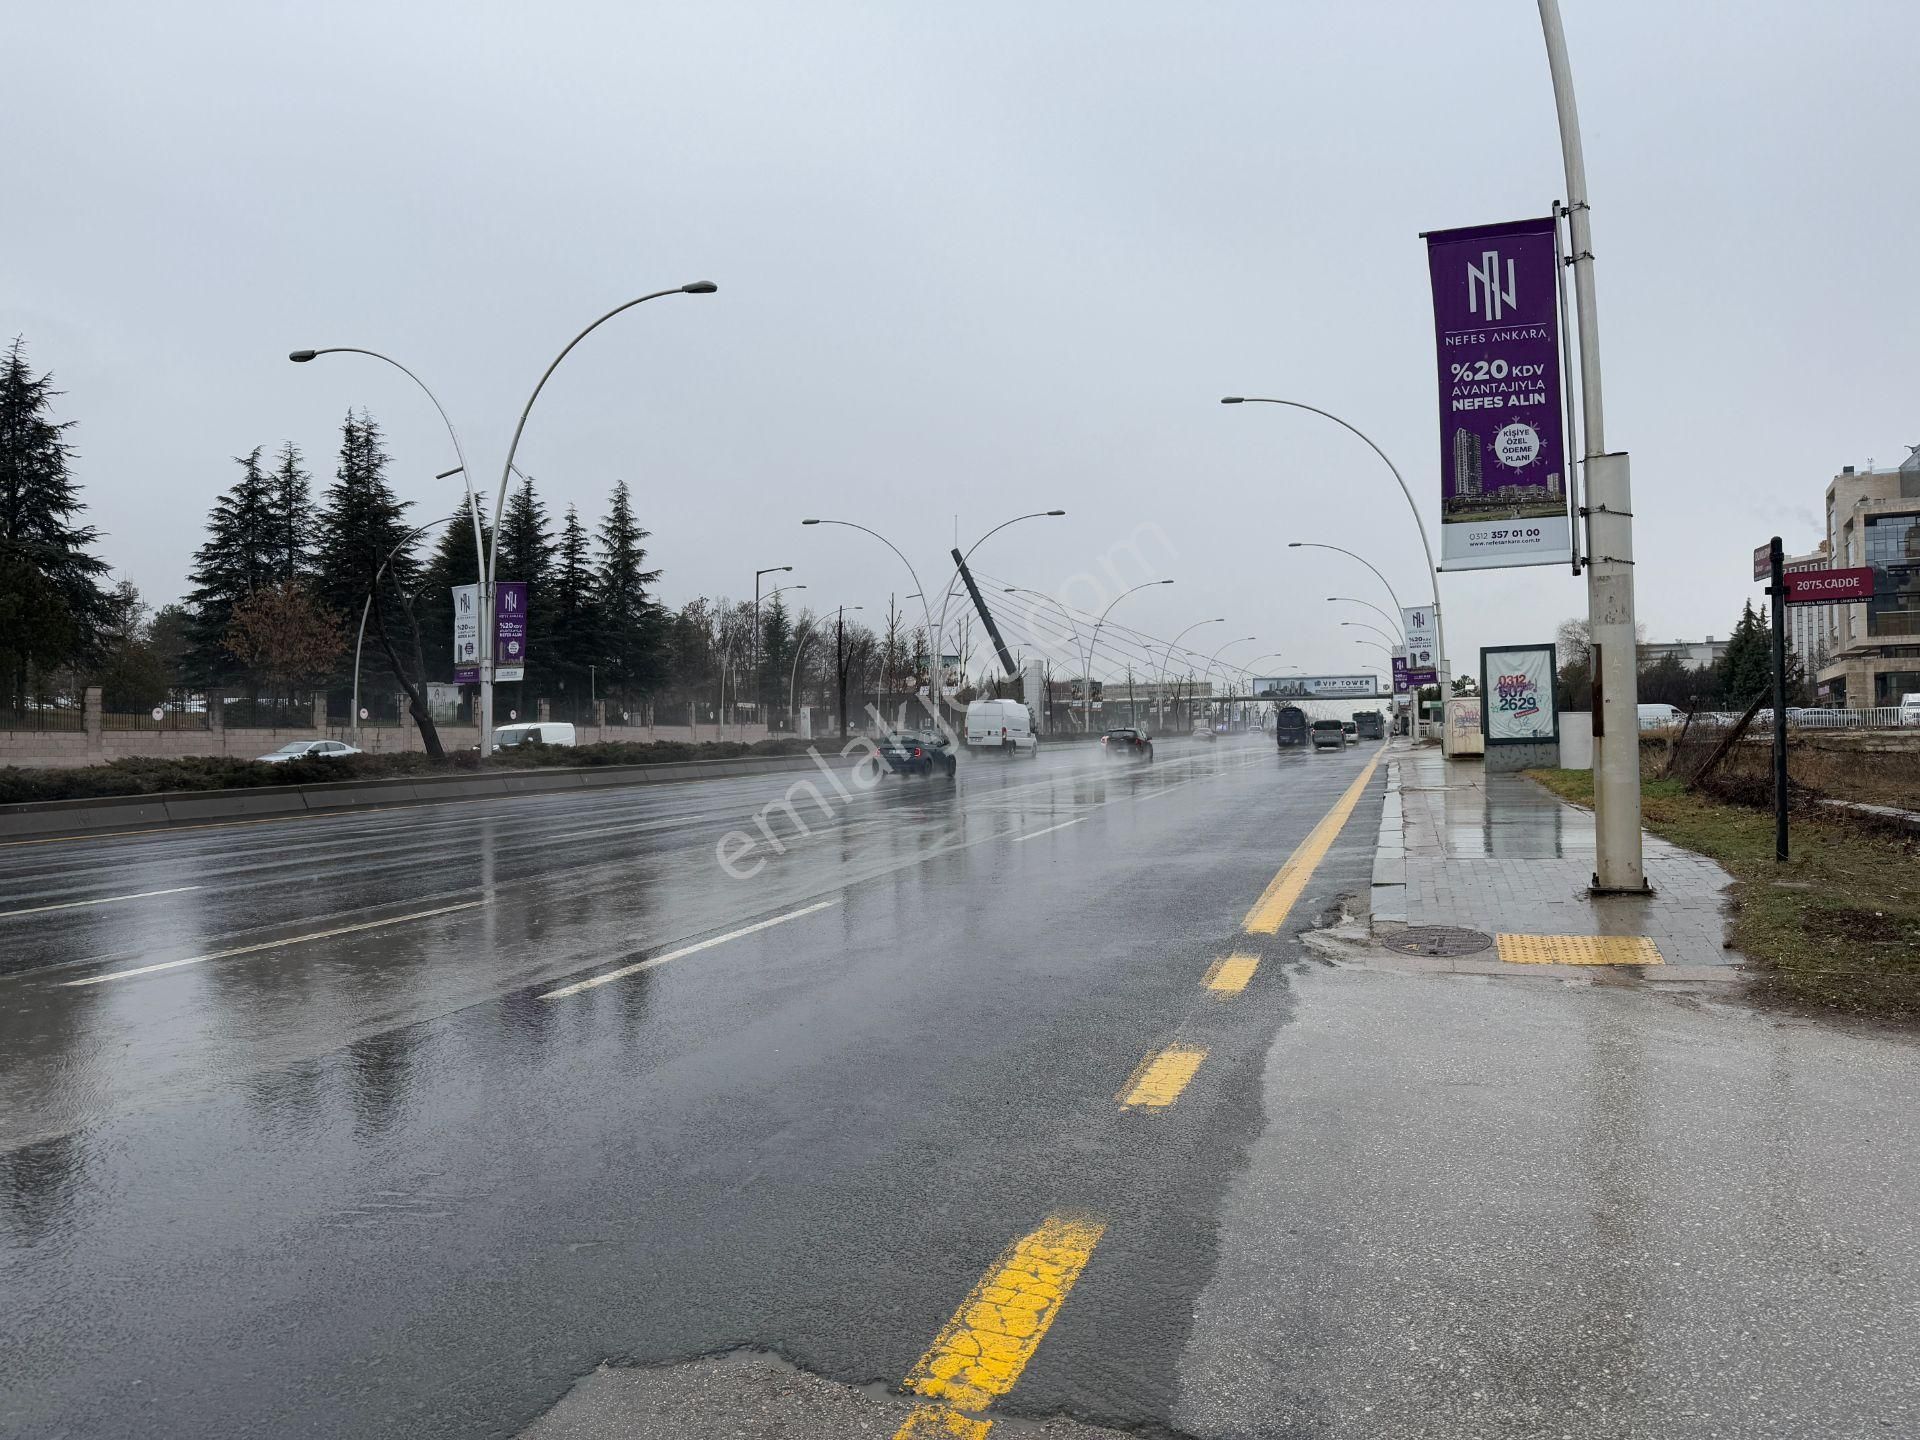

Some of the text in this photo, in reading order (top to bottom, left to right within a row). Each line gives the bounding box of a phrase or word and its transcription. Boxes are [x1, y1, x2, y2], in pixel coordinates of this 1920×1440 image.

[1445, 329, 1547, 346] NEFES ANKARA
[1451, 359, 1545, 383] %20 KDV
[1451, 379, 1546, 397] AVANTAJIYLA
[1452, 392, 1546, 412] NEFES ALIN
[1506, 438, 1528, 446] ÖZEL
[1502, 446, 1533, 454] ÖDEME
[1505, 455, 1530, 463] PLANI
[1469, 528, 1540, 541] 0312 357 01 00
[1796, 577, 1860, 591] 2075.CADDE
[1499, 674, 1526, 686] 0312
[1500, 697, 1536, 710] 2629
